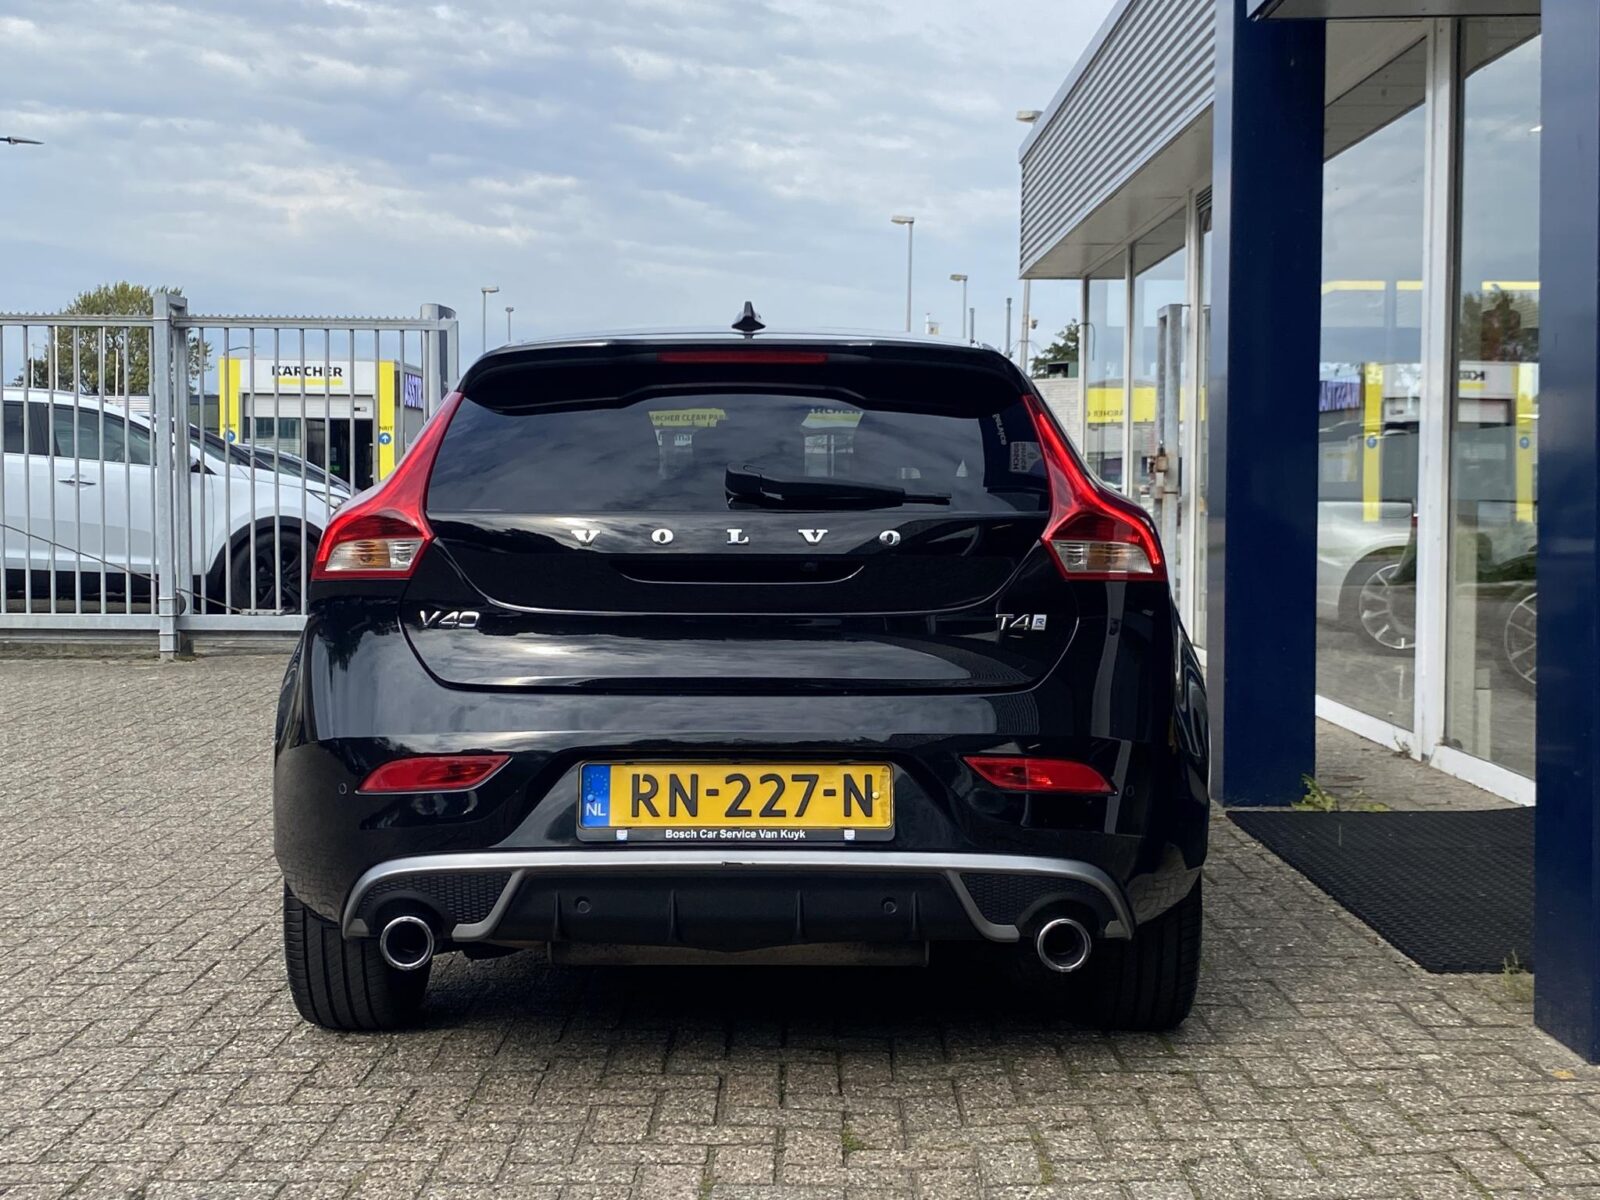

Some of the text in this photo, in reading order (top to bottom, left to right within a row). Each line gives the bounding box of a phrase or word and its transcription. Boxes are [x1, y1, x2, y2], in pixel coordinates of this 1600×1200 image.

[571, 529, 901, 547] VOLVO
[420, 610, 480, 628] V40
[996, 613, 1030, 630] T4
[631, 773, 873, 818] RN-227-N
[586, 804, 606, 817] NL
[665, 829, 806, 841] Bosch Car Service Van Kuyk
